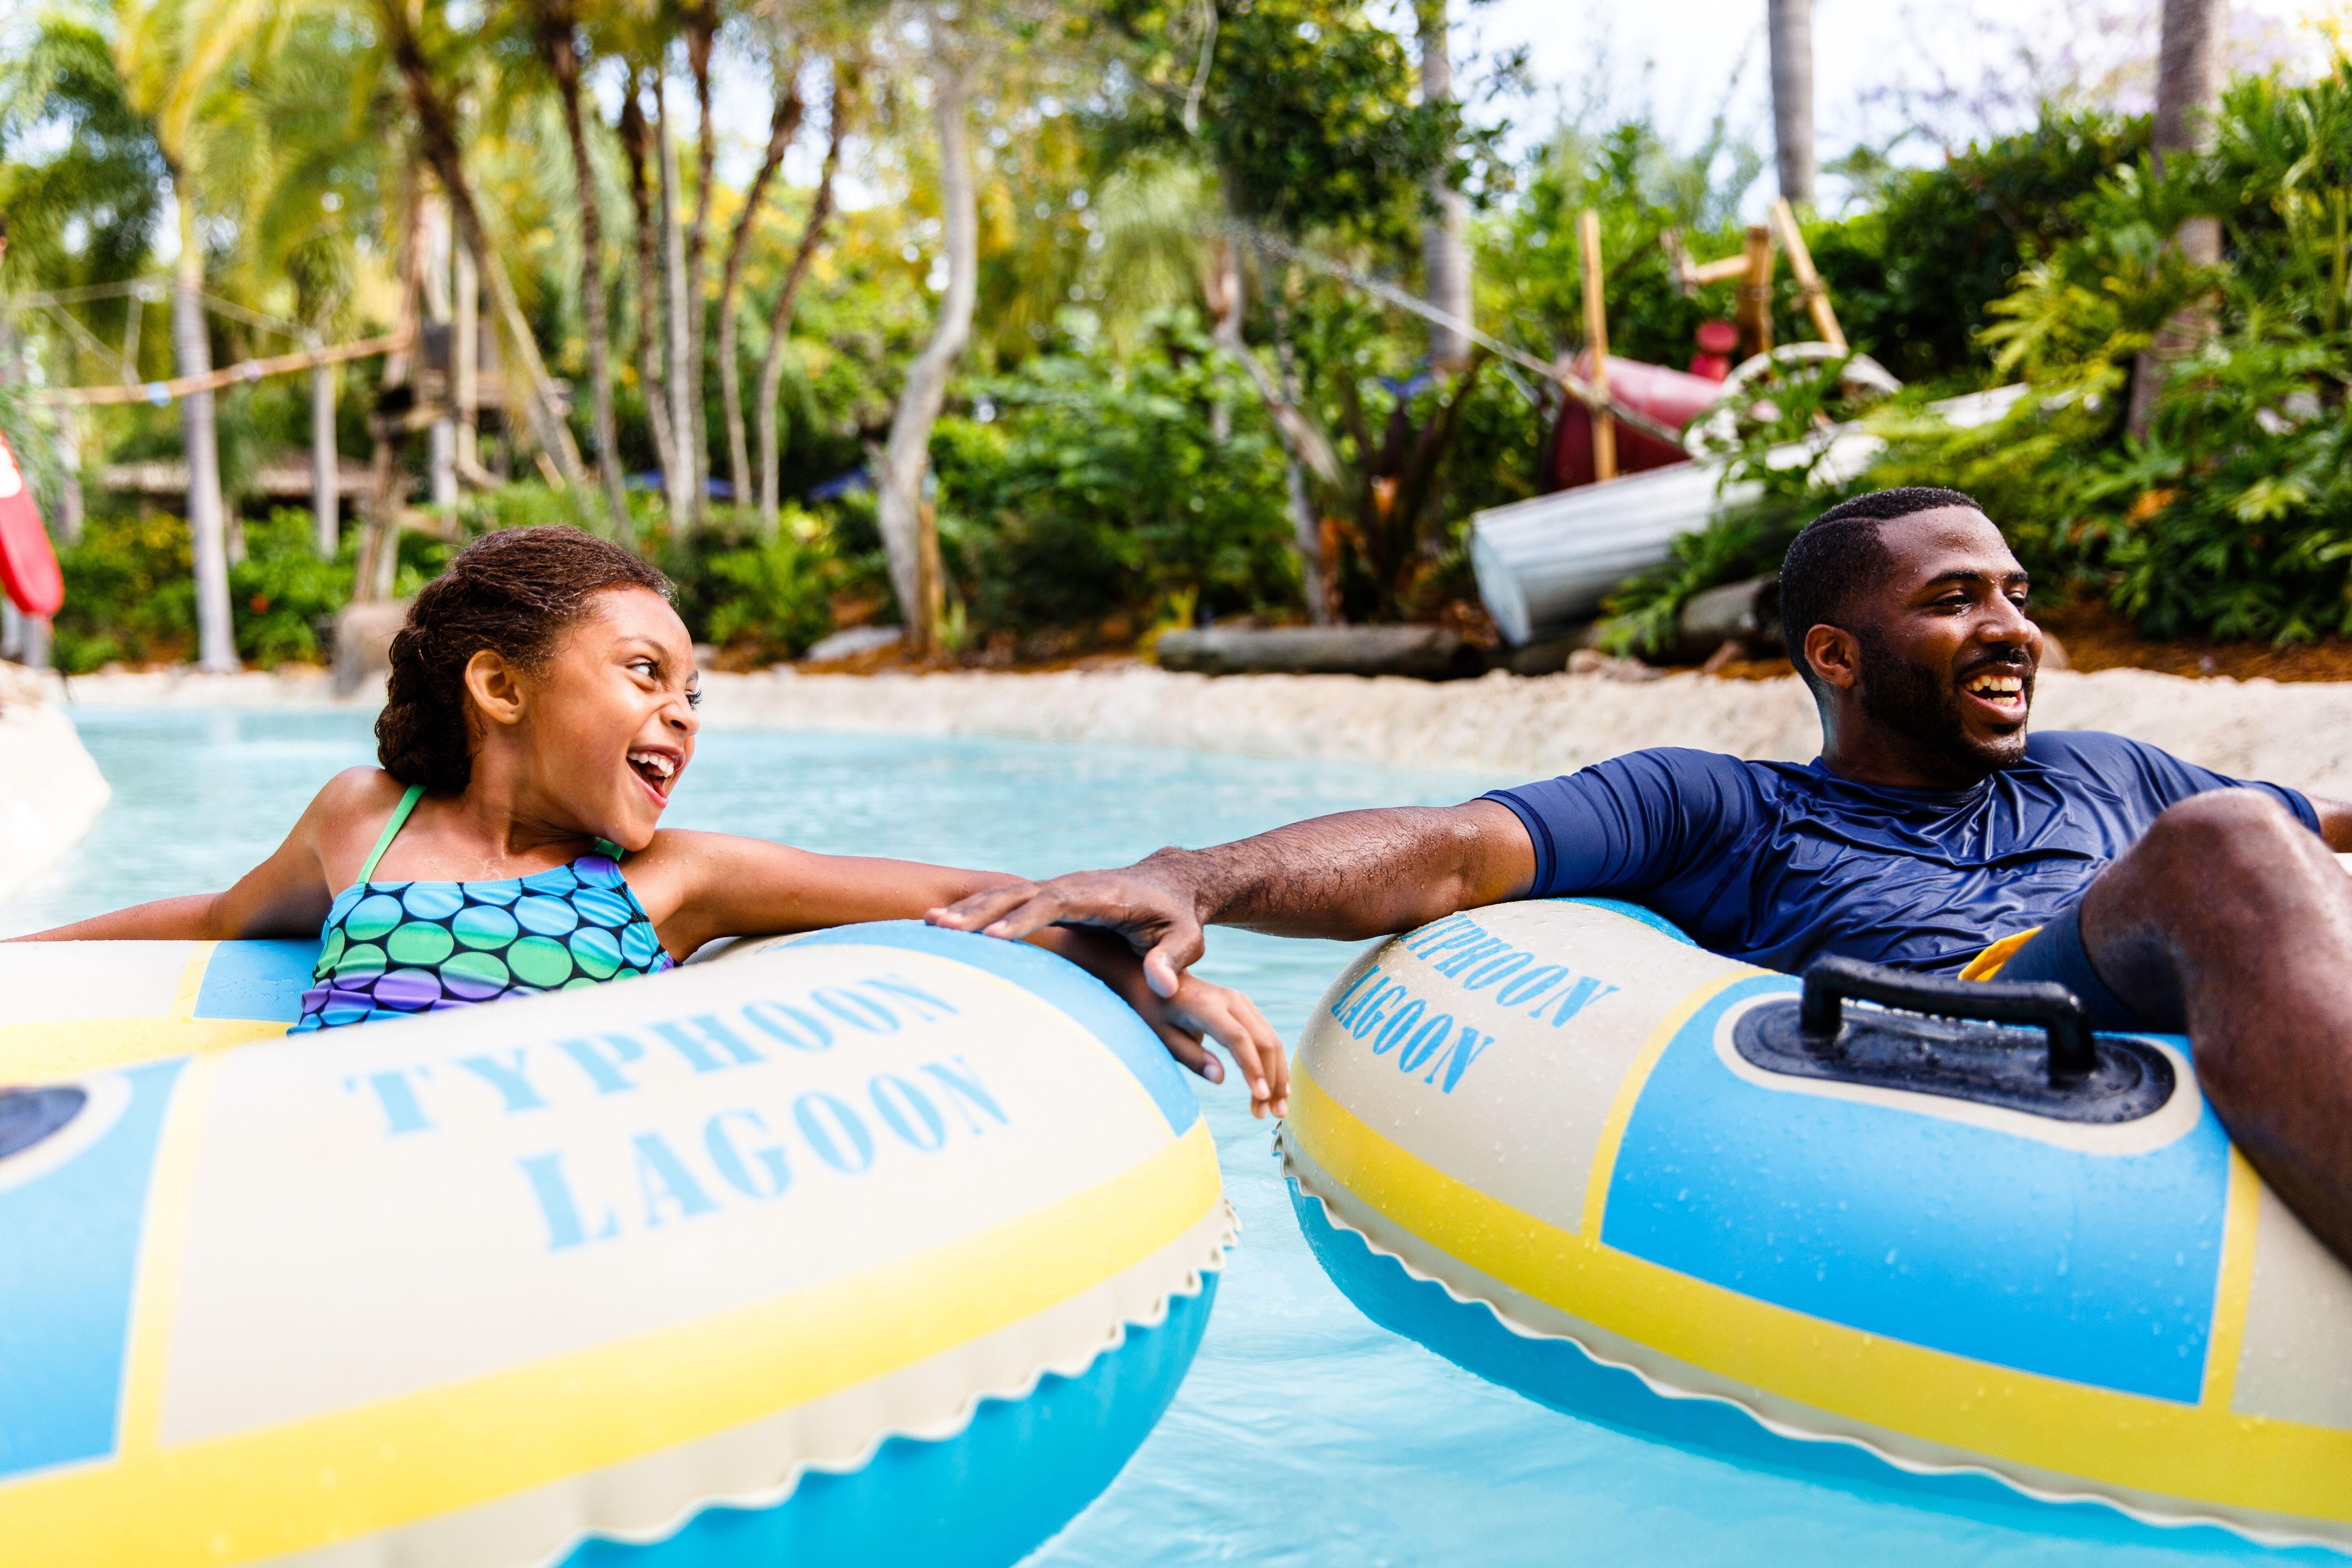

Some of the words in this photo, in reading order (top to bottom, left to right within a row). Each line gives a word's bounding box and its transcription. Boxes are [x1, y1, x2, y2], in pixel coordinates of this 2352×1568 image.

[1331, 965, 1495, 1094] LAGOON
[1401, 913, 1620, 1028] TYPHOON
[341, 972, 962, 1136] TYPHOON
[517, 1055, 1011, 1253] LAGOON
